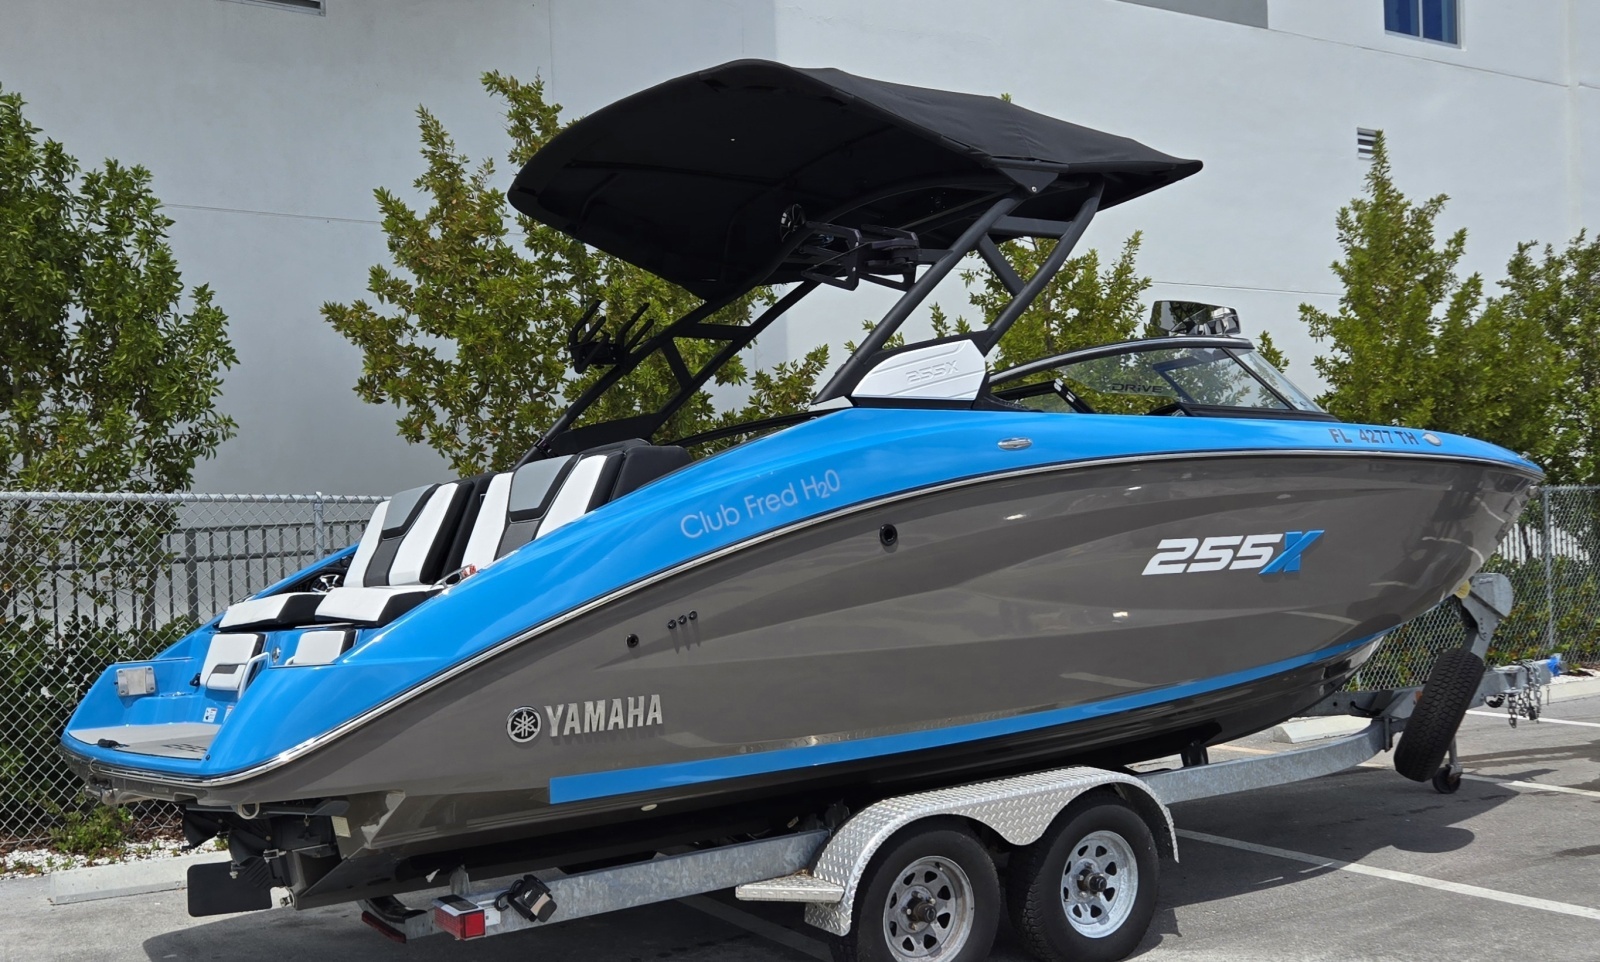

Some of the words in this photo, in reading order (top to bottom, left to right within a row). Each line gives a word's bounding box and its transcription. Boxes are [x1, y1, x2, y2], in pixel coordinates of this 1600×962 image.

[905, 360, 959, 383] 255X
[1328, 428, 1352, 444] FL
[1358, 428, 1394, 444] 4277
[1394, 430, 1420, 445] TH
[680, 504, 740, 539] Club
[743, 482, 798, 519] Fred
[1141, 529, 1325, 576] 255X
[544, 694, 663, 737] YAMAHA
